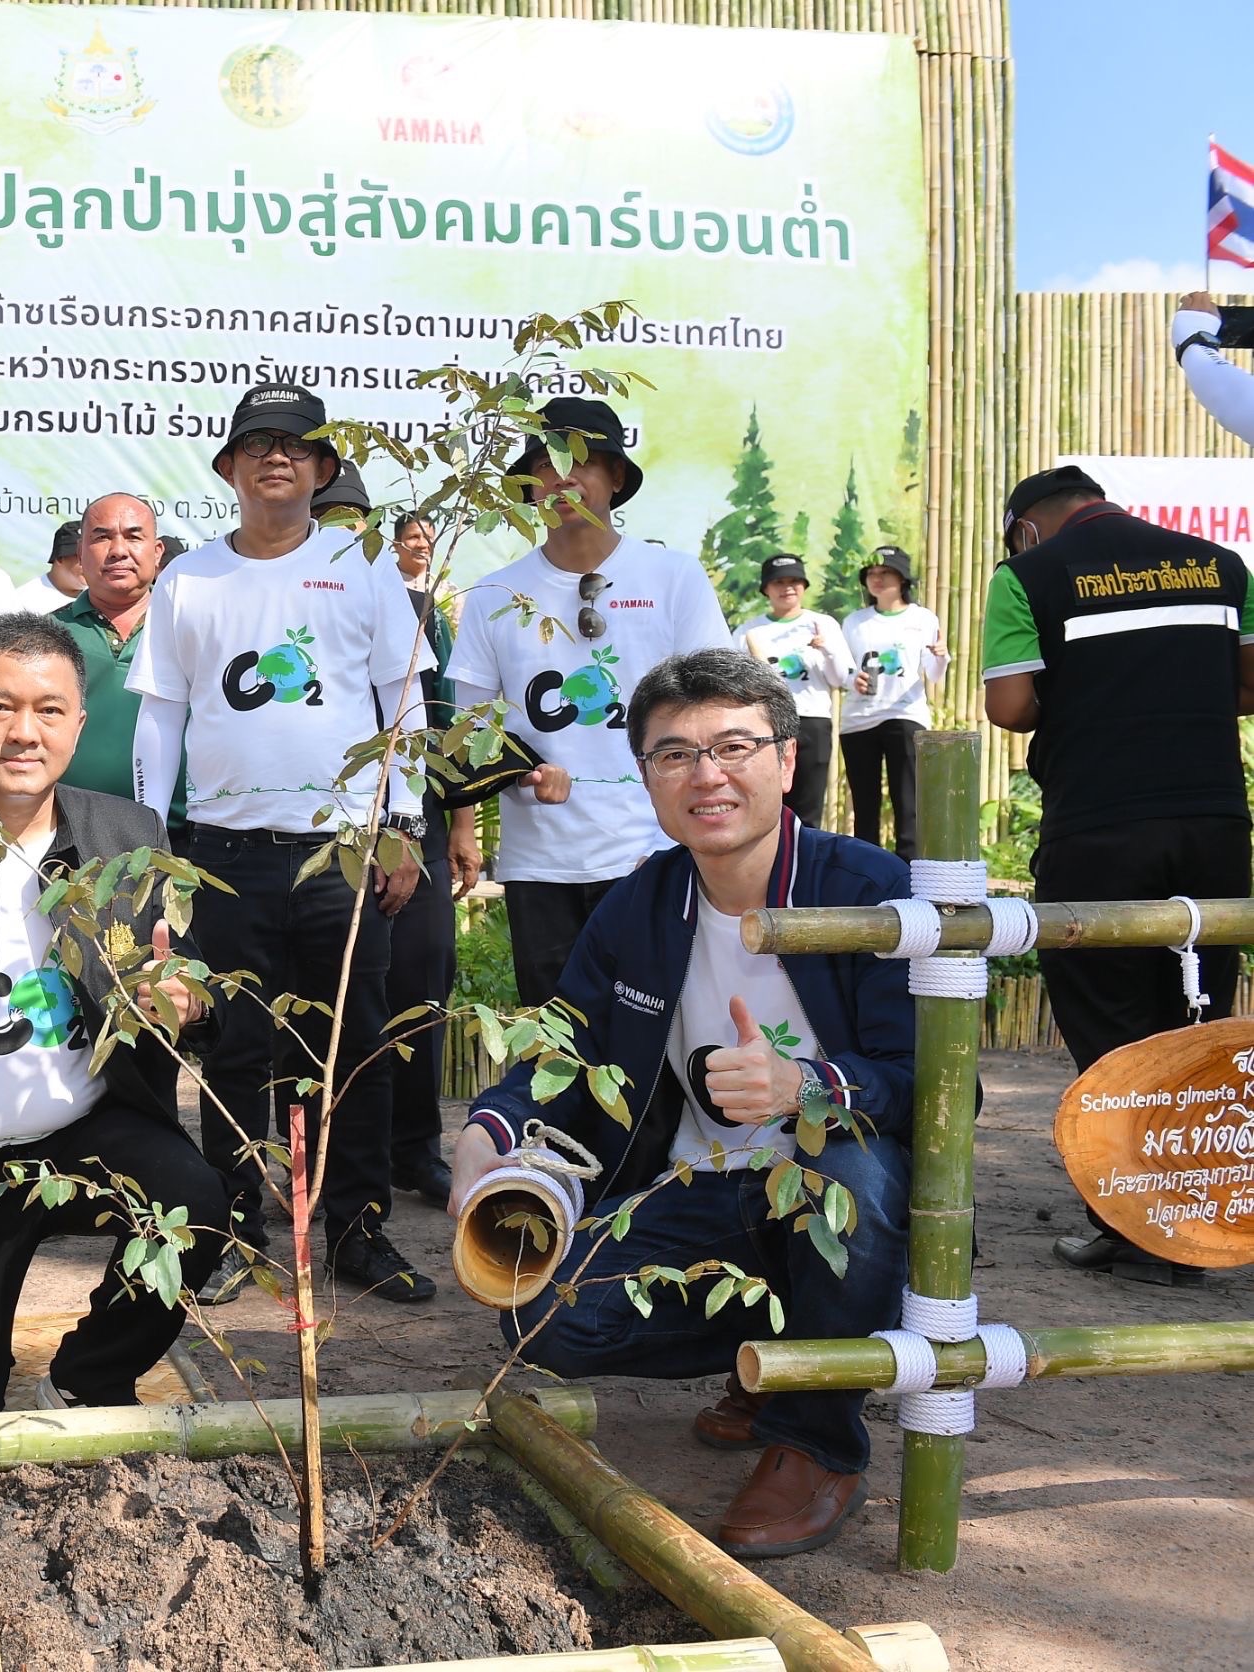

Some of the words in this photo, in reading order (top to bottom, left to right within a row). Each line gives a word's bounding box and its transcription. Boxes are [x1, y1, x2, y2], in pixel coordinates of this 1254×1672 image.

[377, 116, 484, 146] YAMAHA
[260, 390, 300, 402] YAMAHA
[312, 580, 345, 592] YAMAHA
[1075, 556, 1221, 599] กรมประชาสัมพันธ์
[619, 599, 655, 609] YAMAHA
[624, 985, 666, 1012] YAMAHA
[1080, 1088, 1172, 1113] Schoutenia
